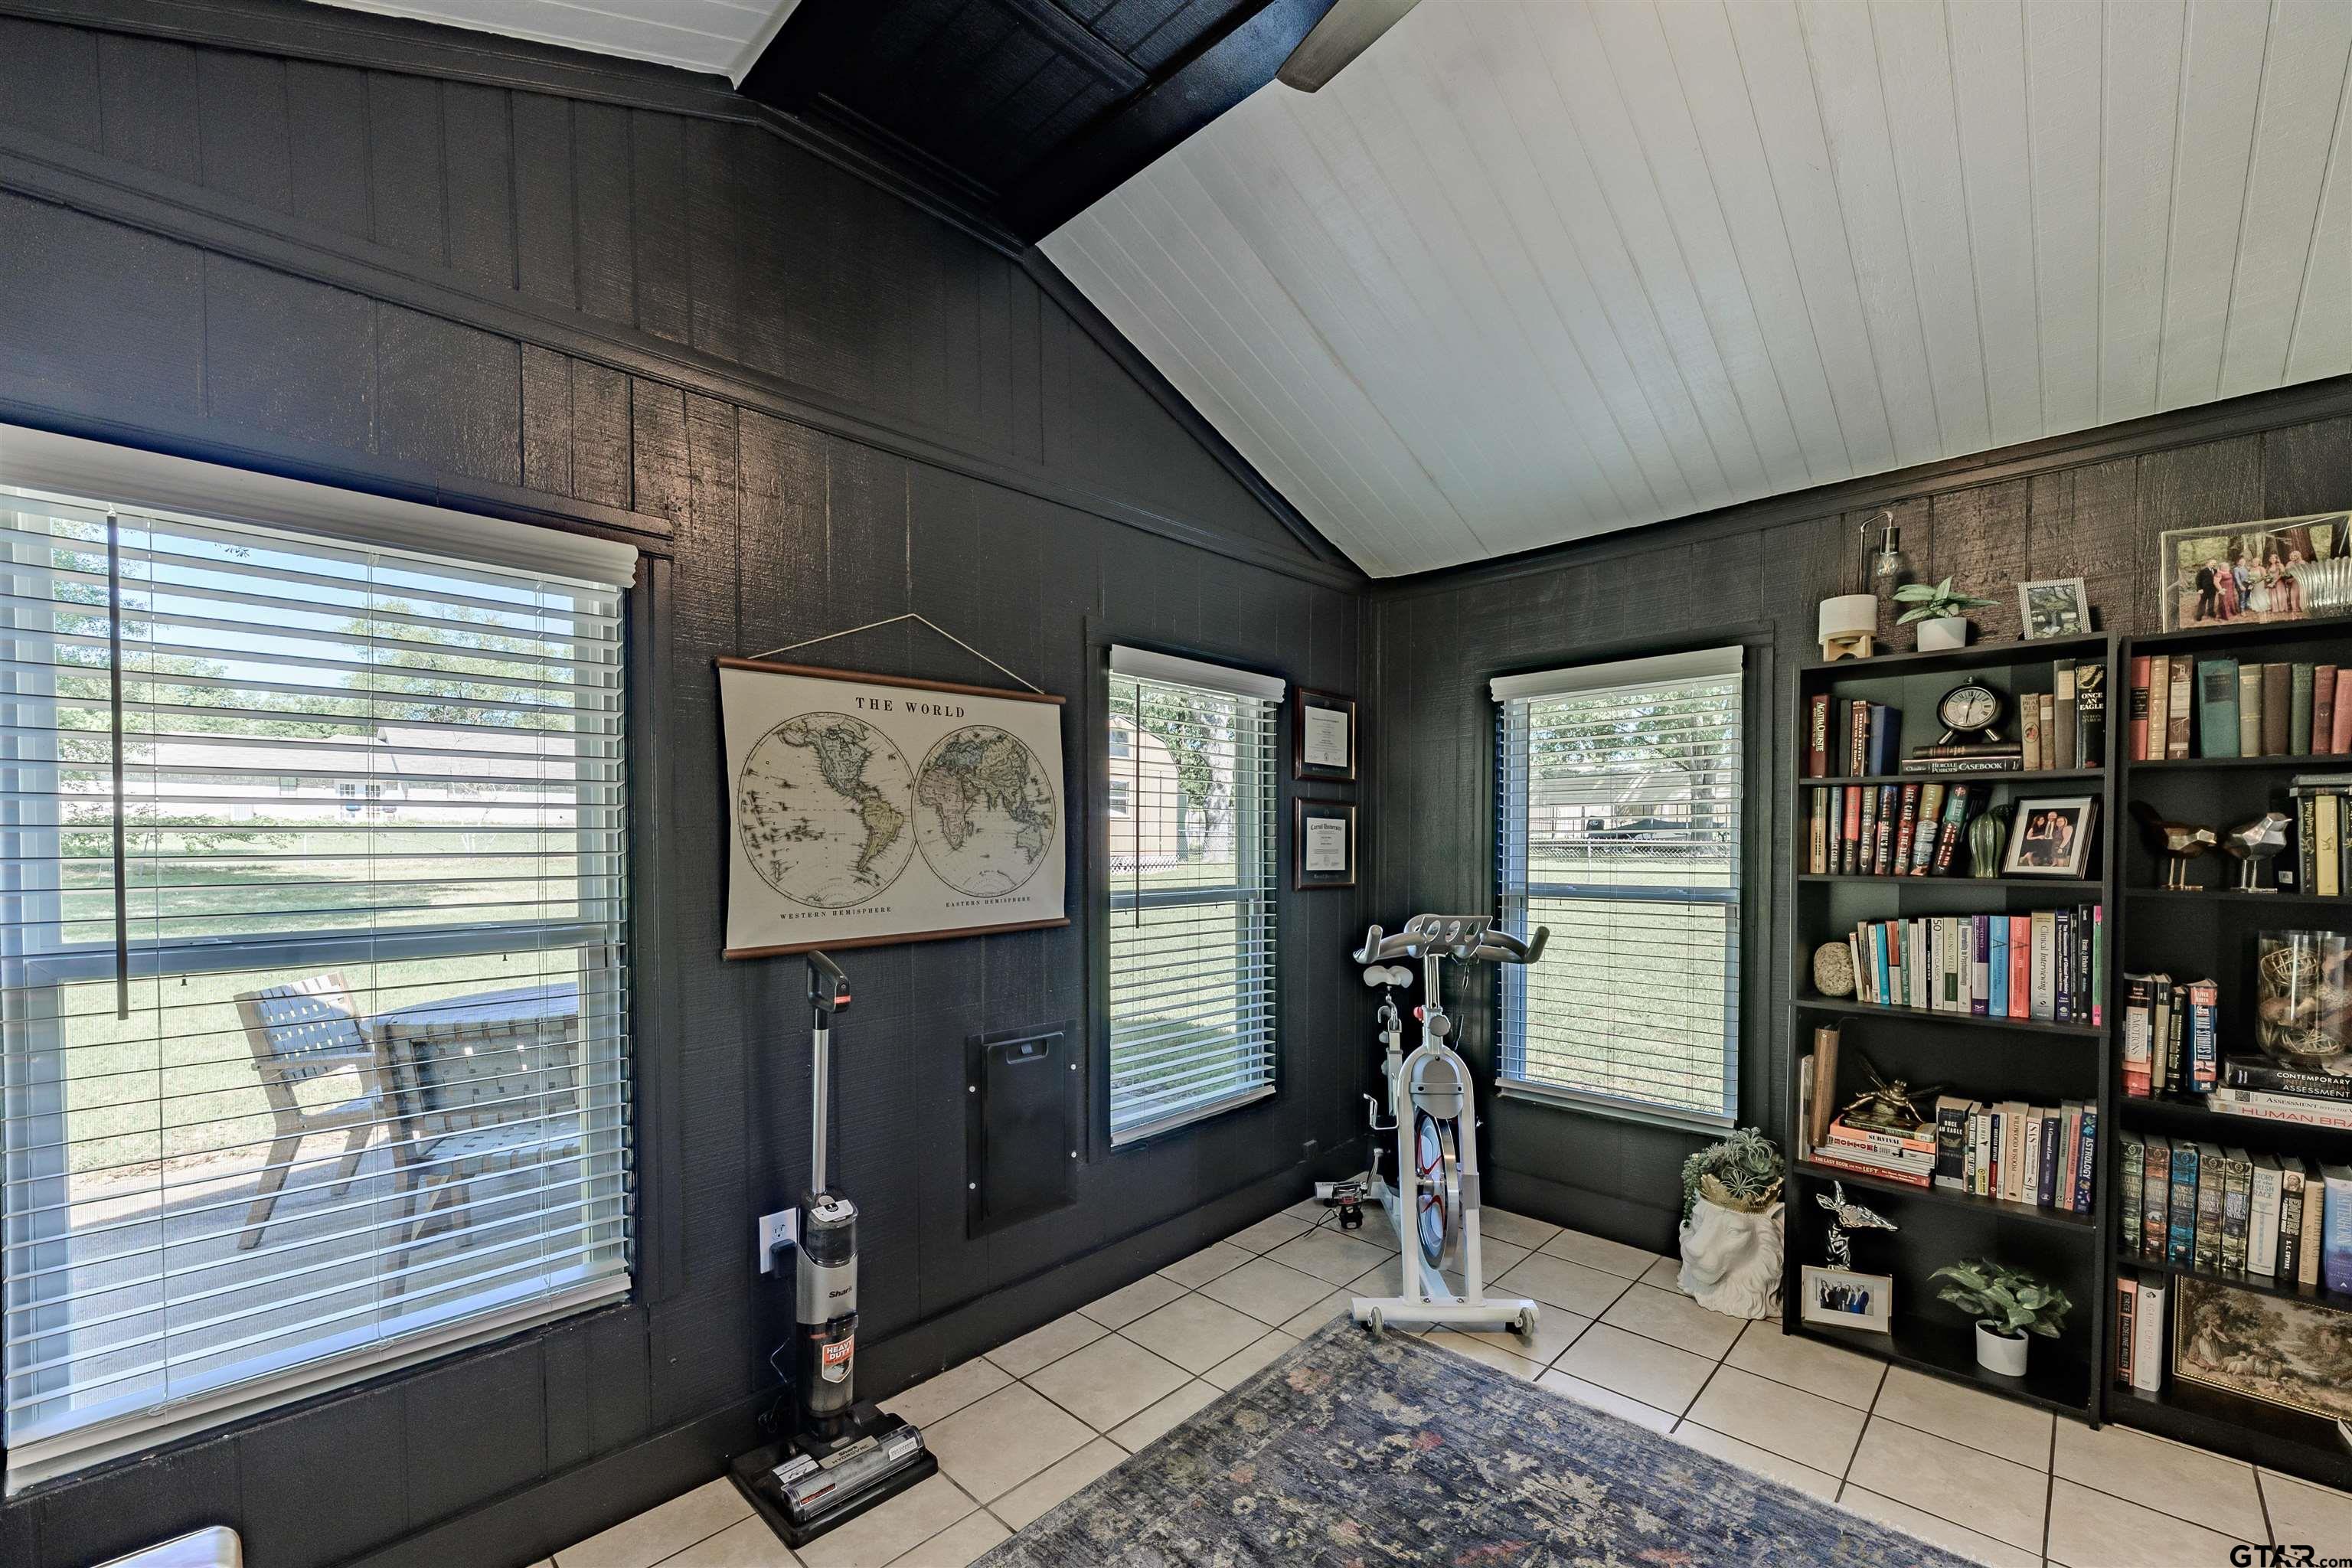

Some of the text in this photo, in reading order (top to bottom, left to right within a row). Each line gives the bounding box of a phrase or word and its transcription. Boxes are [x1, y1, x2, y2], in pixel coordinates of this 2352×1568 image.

[855, 697, 965, 717] THE WORLD
[1816, 702, 1826, 752] AGATHA CHRISTIE
[1904, 787, 1914, 802] JACK
[1864, 791, 1873, 813] SAVAGE
[1903, 805, 1913, 821] CARR
[1862, 831, 1870, 844] JACK
[1861, 845, 1870, 859] CARR
[985, 896, 1031, 905] HEMISPHERE
[780, 906, 892, 920] WESTERN HEMISPHERE
[1933, 919, 1942, 931] 50
[2040, 925, 2050, 951] Clinical
[2037, 952, 2050, 991] Interviewing
[2196, 1017, 2210, 1029] WAR
[2131, 1012, 2143, 1055] EMOTIONS
[2197, 1031, 2211, 1054] STORIES
[2276, 1072, 2350, 1085] CONTEMPORARY
[2282, 1084, 2350, 1098] ASSESSMENT
[2266, 1097, 2318, 1109] ASSESSMENT
[2242, 1107, 2352, 1129] HUMAN BRA
[2012, 1116, 2020, 1148] WILDWOOD
[2028, 1125, 2038, 1143] SAS
[1868, 1134, 1900, 1145] SURVIVAL
[2082, 1137, 2094, 1179] ASTROLOGY
[2253, 1172, 2275, 1181] STORY
[2252, 1190, 2273, 1199] RACE
[2253, 1184, 2274, 1193] IRISH
[2286, 1198, 2302, 1236] EMPIRE
[2122, 1317, 2130, 1348] MADELINE
[827, 1340, 852, 1354] HEAVY
[830, 1348, 851, 1360] DUTY
